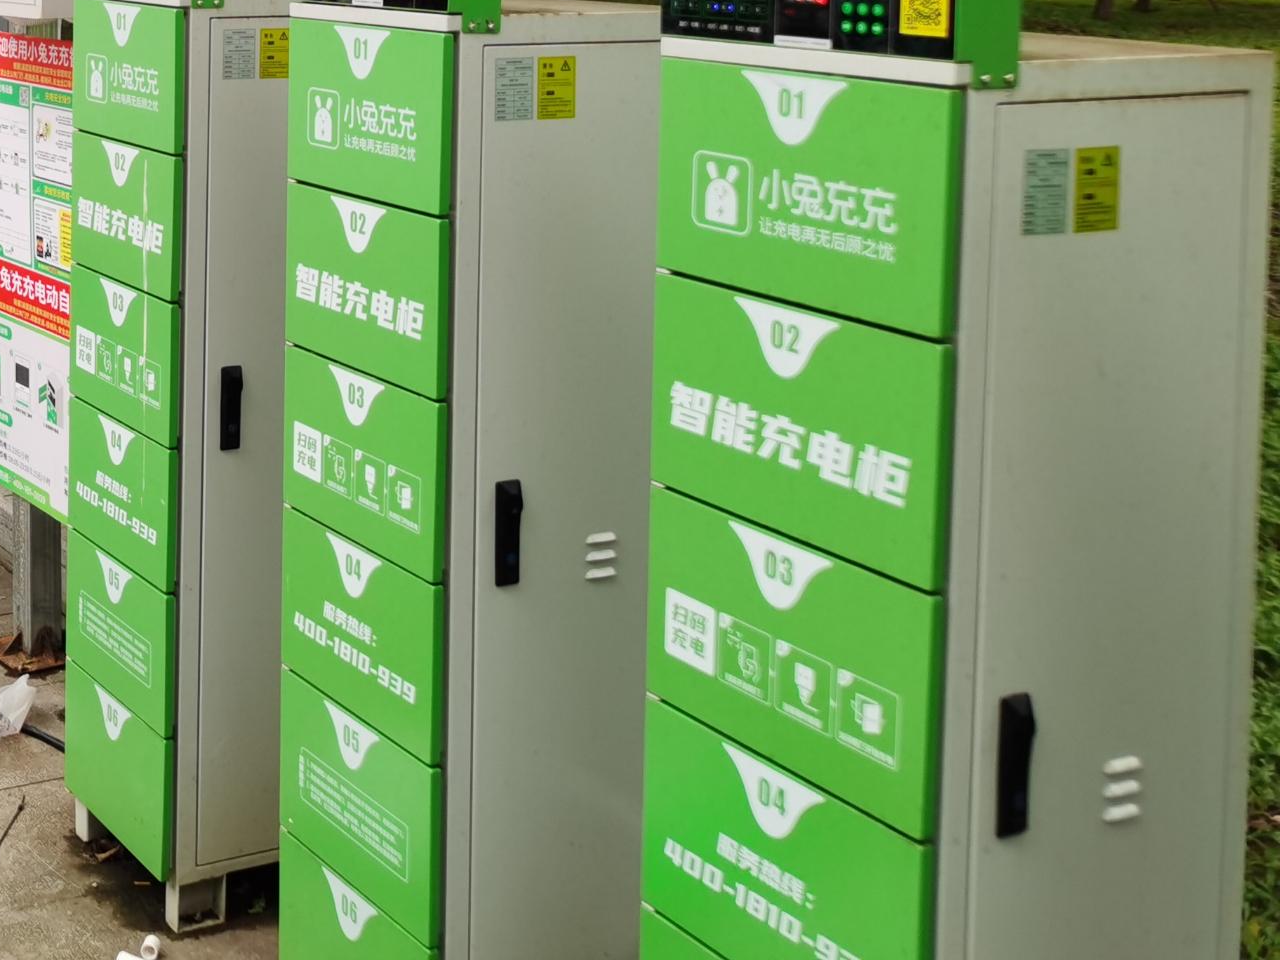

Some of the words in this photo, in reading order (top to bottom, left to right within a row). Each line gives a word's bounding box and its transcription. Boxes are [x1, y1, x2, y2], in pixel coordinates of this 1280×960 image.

[116, 12, 127, 31] 01
[354, 37, 368, 60] 01
[110, 62, 159, 95] 小兔充充
[344, 98, 417, 141] 小兔充充
[778, 87, 805, 120] 01
[114, 151, 126, 172] 02
[344, 135, 416, 162] 让充电再无后顾之忧
[758, 169, 898, 235] 小兔充充
[77, 196, 164, 255] 智能充电柜
[349, 210, 367, 236] 02
[758, 216, 897, 264] 让充电再无后顾之忧
[112, 292, 124, 312] 03
[296, 263, 424, 341] 智能充电柜
[771, 320, 800, 354] 02
[348, 382, 365, 409] 03
[110, 431, 122, 452] 04
[297, 431, 317, 455] 扫码
[670, 380, 913, 509] 智能充电柜
[297, 448, 317, 472] 充电
[76, 480, 157, 546] 400-1810-939
[108, 568, 120, 590] 05
[345, 553, 362, 581] 04
[764, 550, 794, 586] 03
[671, 602, 707, 635] 扫码
[293, 610, 417, 705] 400-1810-939
[671, 627, 705, 660] 充电
[107, 705, 119, 728] 06
[343, 724, 360, 753] 05
[757, 777, 786, 816] 04
[341, 894, 358, 923] 06
[664, 837, 862, 960] 400-1810-9
